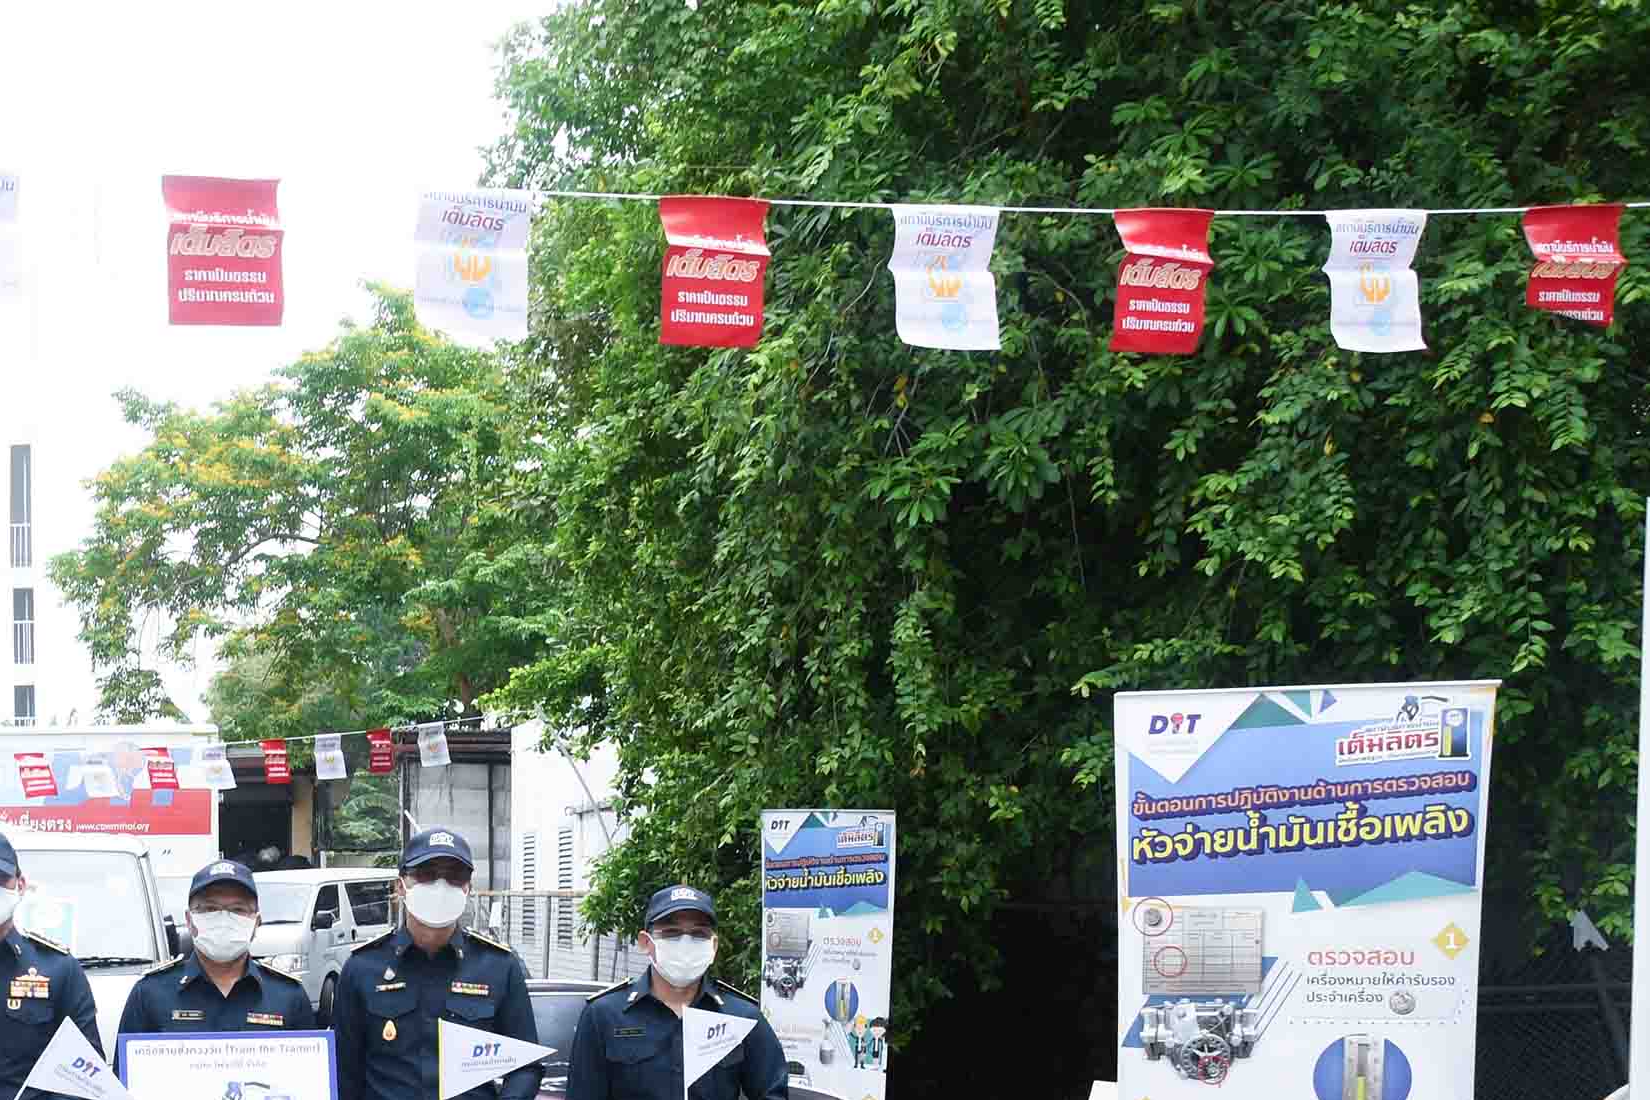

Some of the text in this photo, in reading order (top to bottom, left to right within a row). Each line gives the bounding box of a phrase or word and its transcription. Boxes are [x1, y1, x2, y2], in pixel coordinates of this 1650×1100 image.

[1348, 235, 1399, 256] เต็มลิตร
[1149, 713, 1201, 735] DIT
[1337, 728, 1439, 756] เต็มลิตร
[1132, 801, 1469, 862] หัวจ่ายน้ำมันเชื้อเพลิง
[1446, 932, 1457, 949] 1
[1307, 950, 1416, 967] ตรวจสอบ
